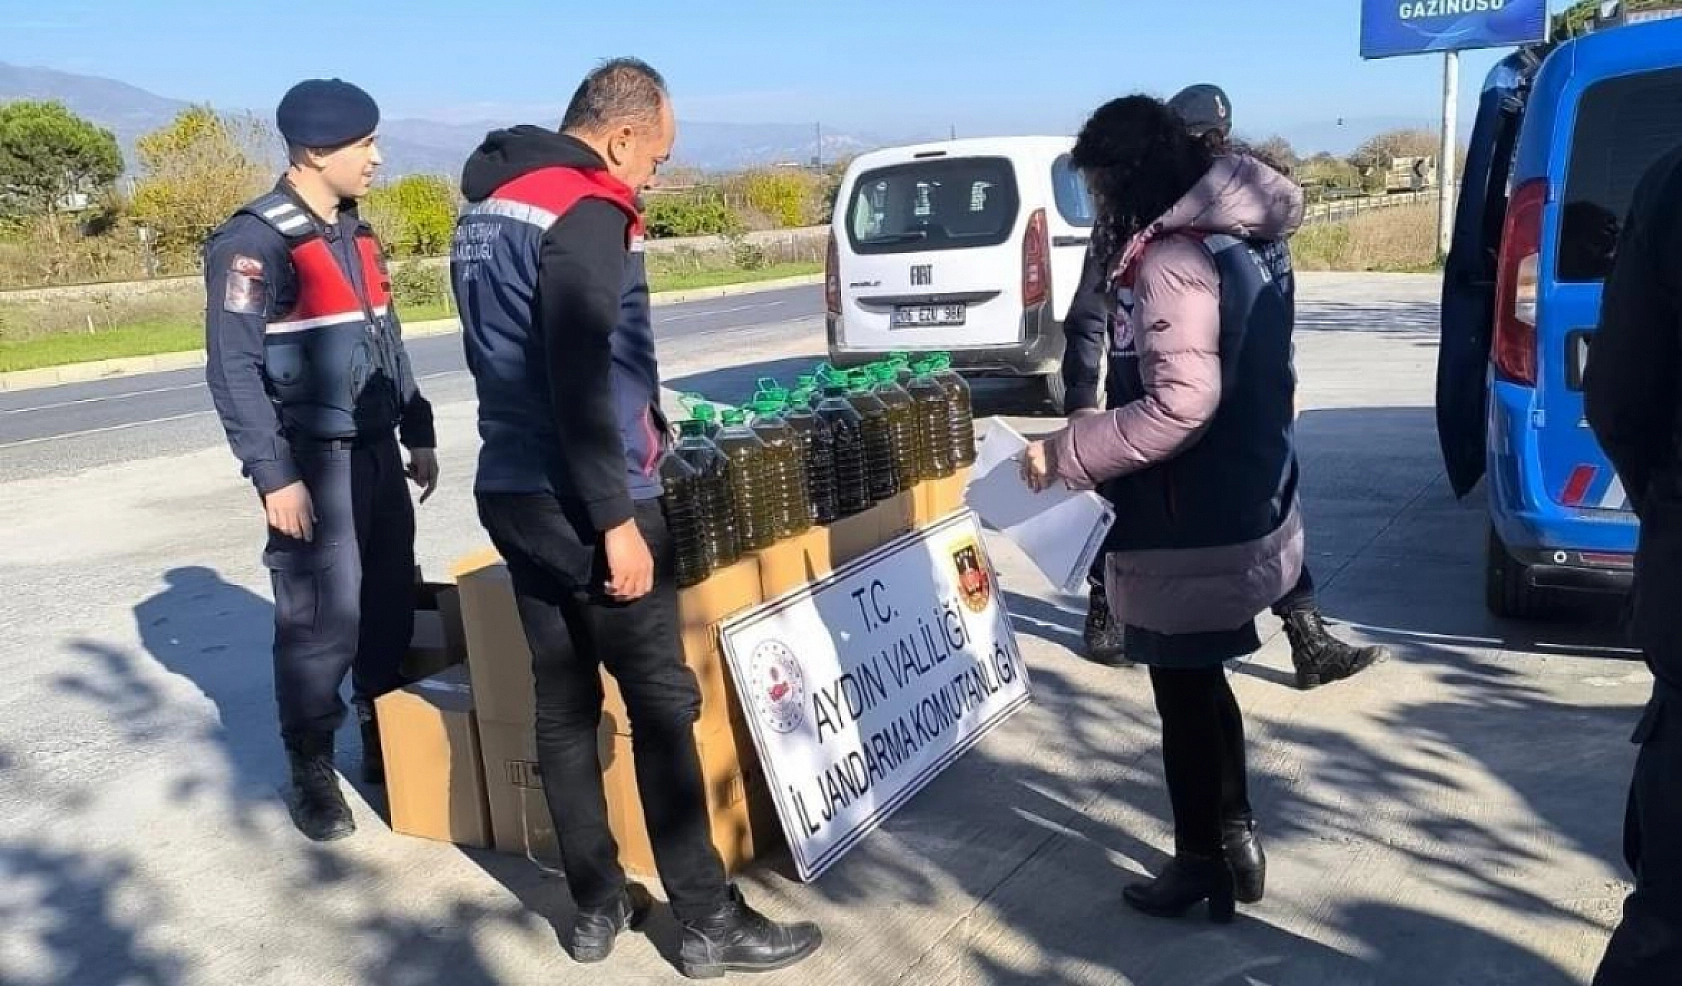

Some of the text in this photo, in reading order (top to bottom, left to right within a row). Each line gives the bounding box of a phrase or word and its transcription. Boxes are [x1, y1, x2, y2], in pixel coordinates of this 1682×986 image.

[910, 264, 933, 285] FIAT
[852, 579, 900, 634] T.C.
[812, 597, 971, 743] AYDIN VALİLİĞİ
[788, 643, 1017, 839] İL JANDARMA KOMUTANLIĞI
